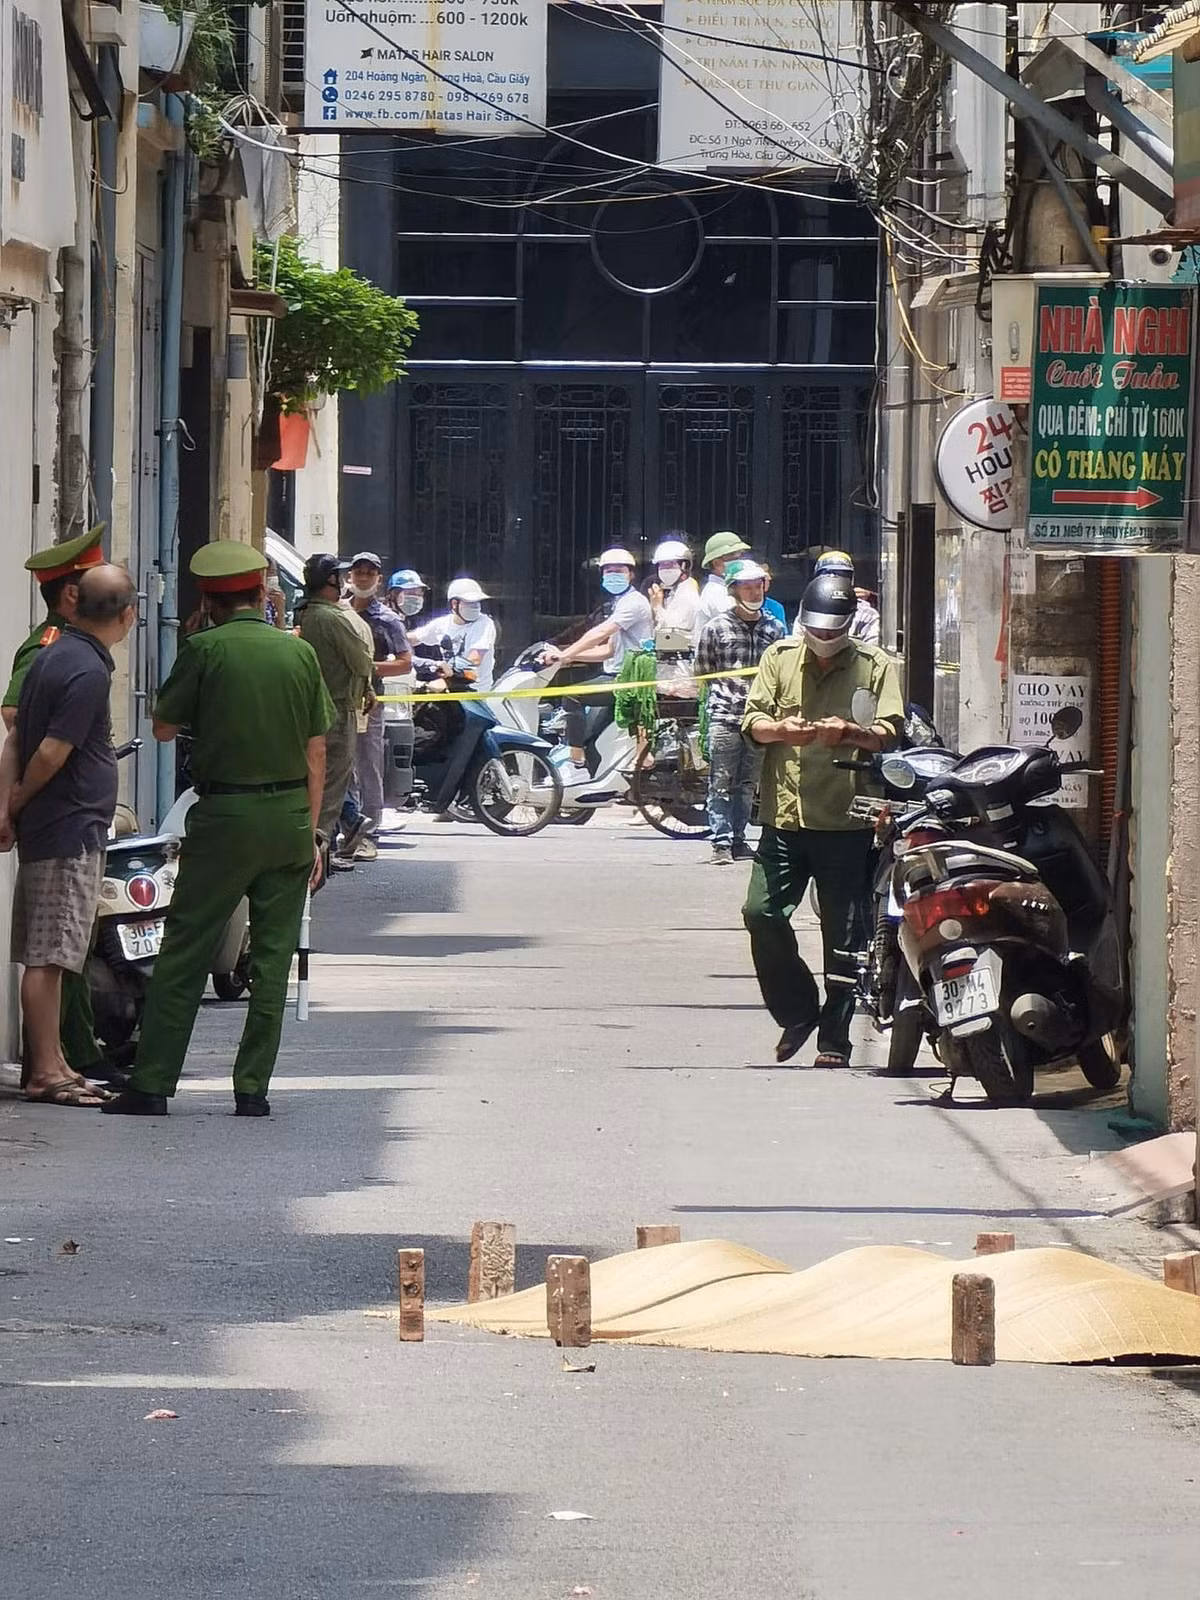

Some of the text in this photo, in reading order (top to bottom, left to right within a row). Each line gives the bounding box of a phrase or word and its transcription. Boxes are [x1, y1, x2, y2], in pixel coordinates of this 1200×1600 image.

[481, 12, 529, 26] 1200k
[377, 49, 494, 61] MATAS HAIR SALON
[345, 70, 364, 81] 204
[345, 90, 375, 101] 0246
[378, 90, 401, 102] 295
[404, 91, 435, 102] 8780
[447, 91, 470, 102] 098
[506, 93, 529, 104] 678
[466, 110, 491, 121] Hair
[770, 121, 789, 131] 66
[1040, 296, 1105, 354] NHÀ
[1038, 404, 1064, 438] QUA
[1105, 396, 1129, 437] CHỈ
[1152, 407, 1185, 438] 160K
[968, 413, 1012, 455] 24
[965, 446, 1012, 483] HOU
[1035, 441, 1186, 481] CÓ THANG MÁY
[1049, 524, 1060, 538] 21
[1086, 525, 1097, 538] 71
[1018, 683, 1087, 698] CHO VAY
